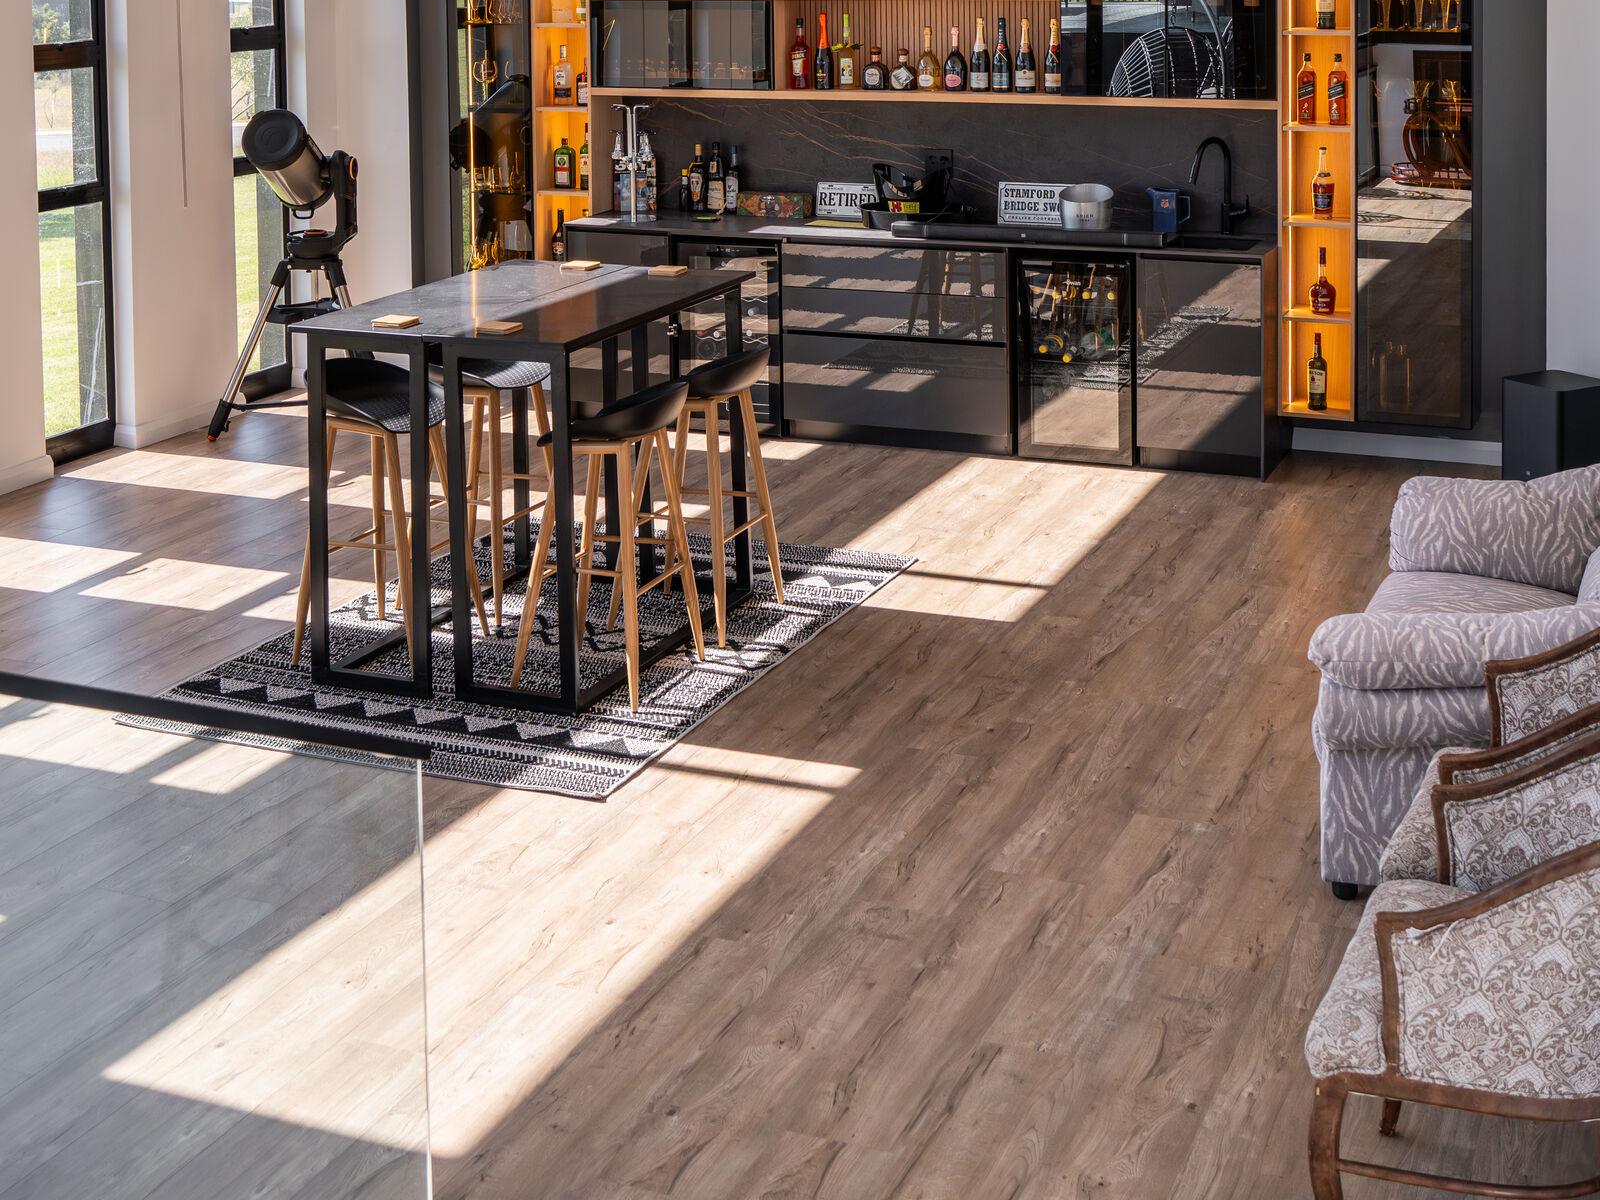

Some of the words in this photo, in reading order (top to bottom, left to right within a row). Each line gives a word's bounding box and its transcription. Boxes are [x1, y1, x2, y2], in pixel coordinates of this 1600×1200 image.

[1004, 188, 1056, 199] STAMFORD
[819, 192, 876, 207] RETIRED
[1004, 201, 1039, 211] BRIDGE
